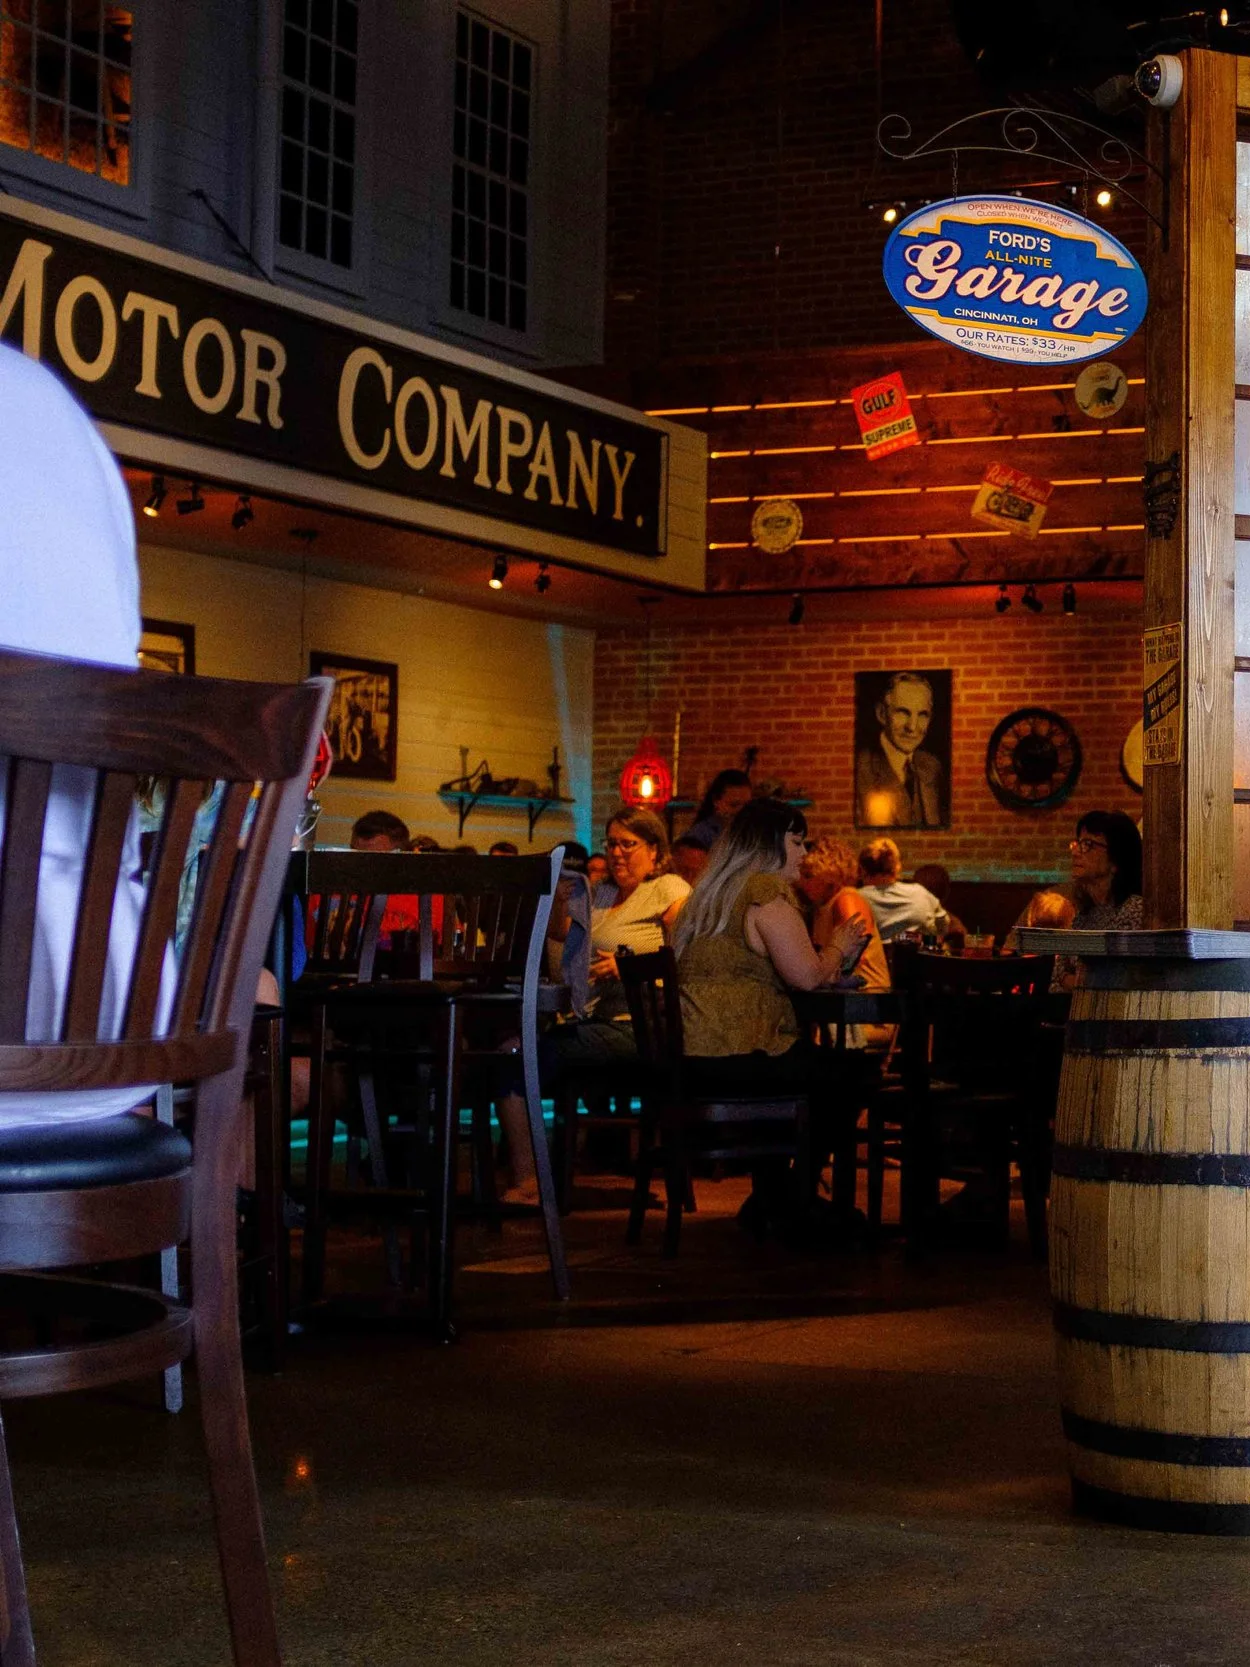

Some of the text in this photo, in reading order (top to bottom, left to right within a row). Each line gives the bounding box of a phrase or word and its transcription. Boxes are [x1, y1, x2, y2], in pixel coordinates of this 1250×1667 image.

[967, 203, 1073, 227] OPEN WHEN WE'RE HERE
[1008, 212, 1031, 220] WHEN
[1032, 216, 1044, 224] WE
[988, 230, 1052, 252] FORD'S
[984, 250, 1053, 269] ALL-NITE
[904, 240, 1129, 329] Garage
[1021, 317, 1039, 326] OH
[956, 327, 984, 341] OUR
[986, 331, 1029, 347] RATES:
[1031, 337, 1056, 350] $33
[992, 344, 1015, 352] WATCH
[862, 388, 896, 414] GULF
[338, 346, 644, 528] COMPANY.
[865, 419, 913, 446] SUPREME
